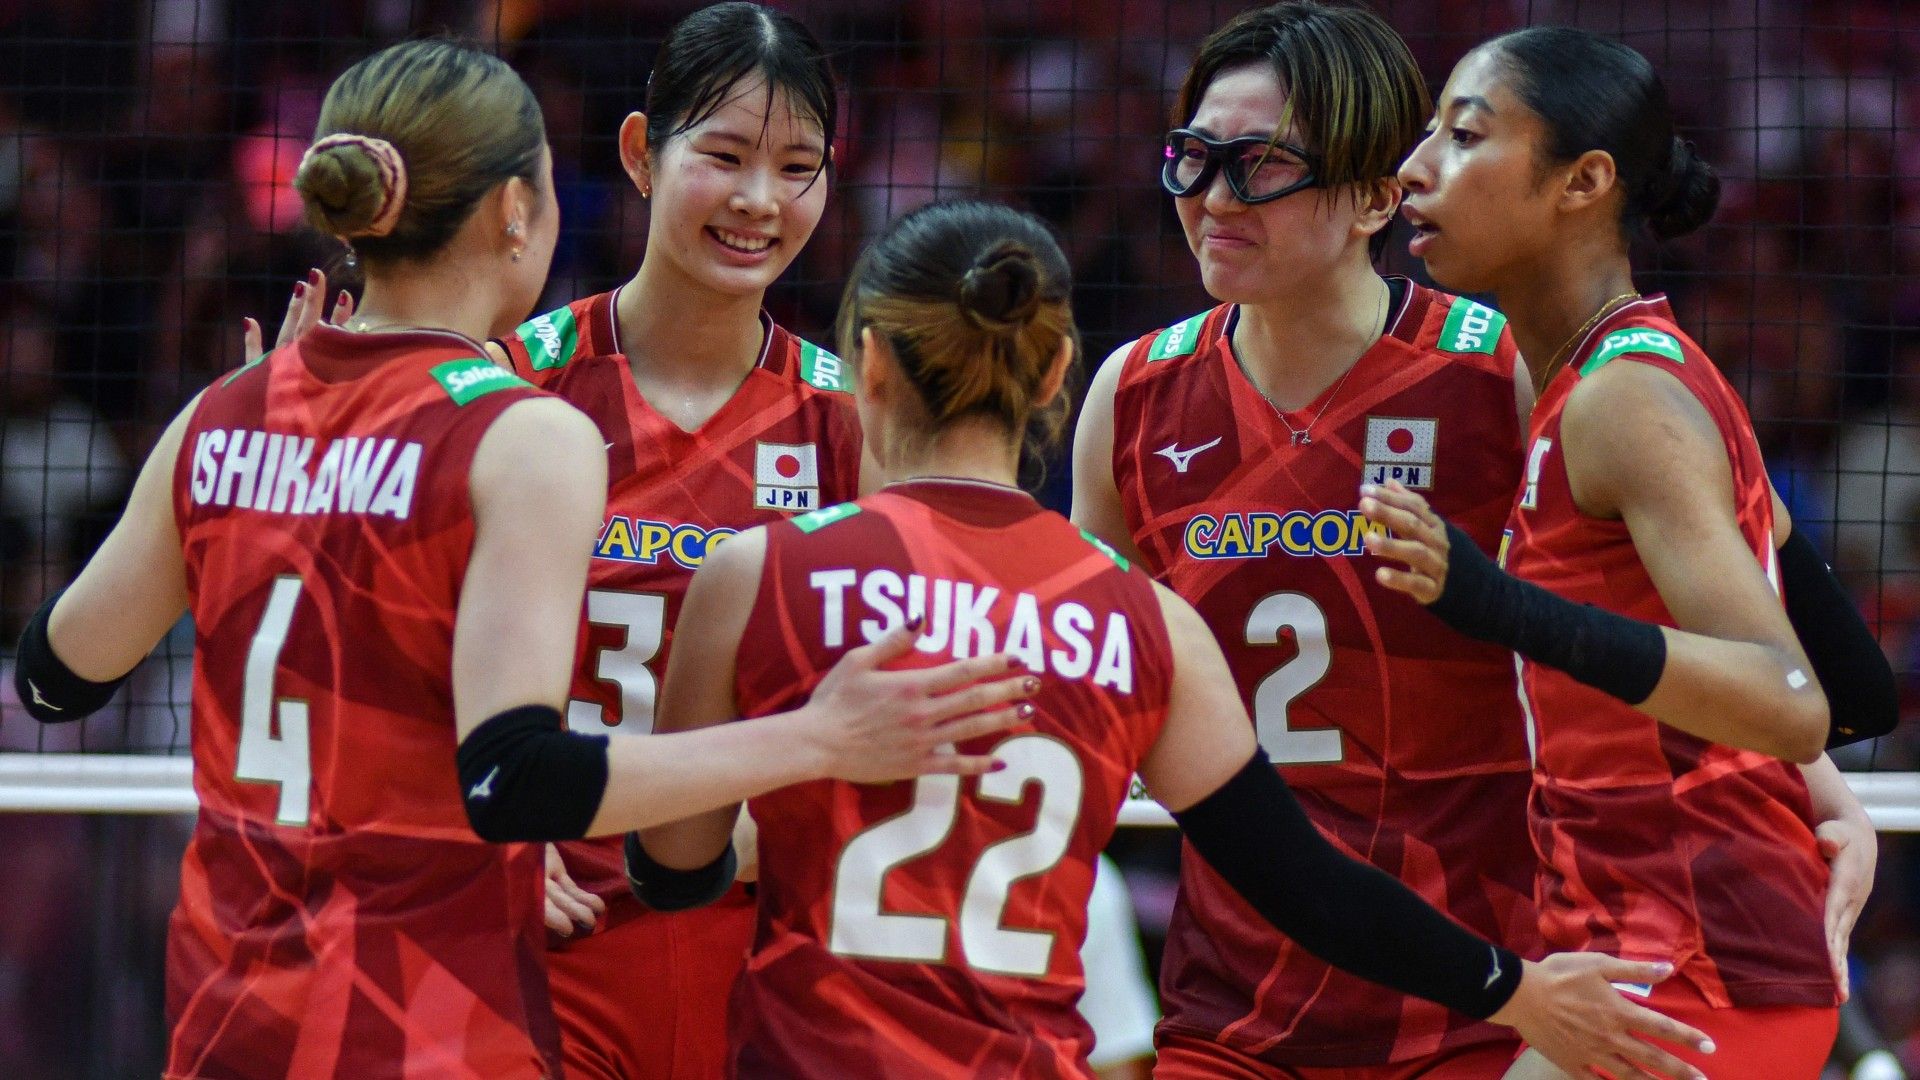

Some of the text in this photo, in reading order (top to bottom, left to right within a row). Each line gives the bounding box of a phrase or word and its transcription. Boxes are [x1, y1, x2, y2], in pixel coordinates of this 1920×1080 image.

[191, 429, 424, 520] ISHIKAWA
[766, 488, 809, 508] JPN
[1373, 466, 1420, 486] JPN
[592, 515, 740, 569] APC
[565, 588, 667, 735] 3
[809, 568, 1135, 696] TSUKASA
[1243, 590, 1346, 765] 2
[234, 573, 312, 827] 4
[829, 733, 1085, 978] 22
